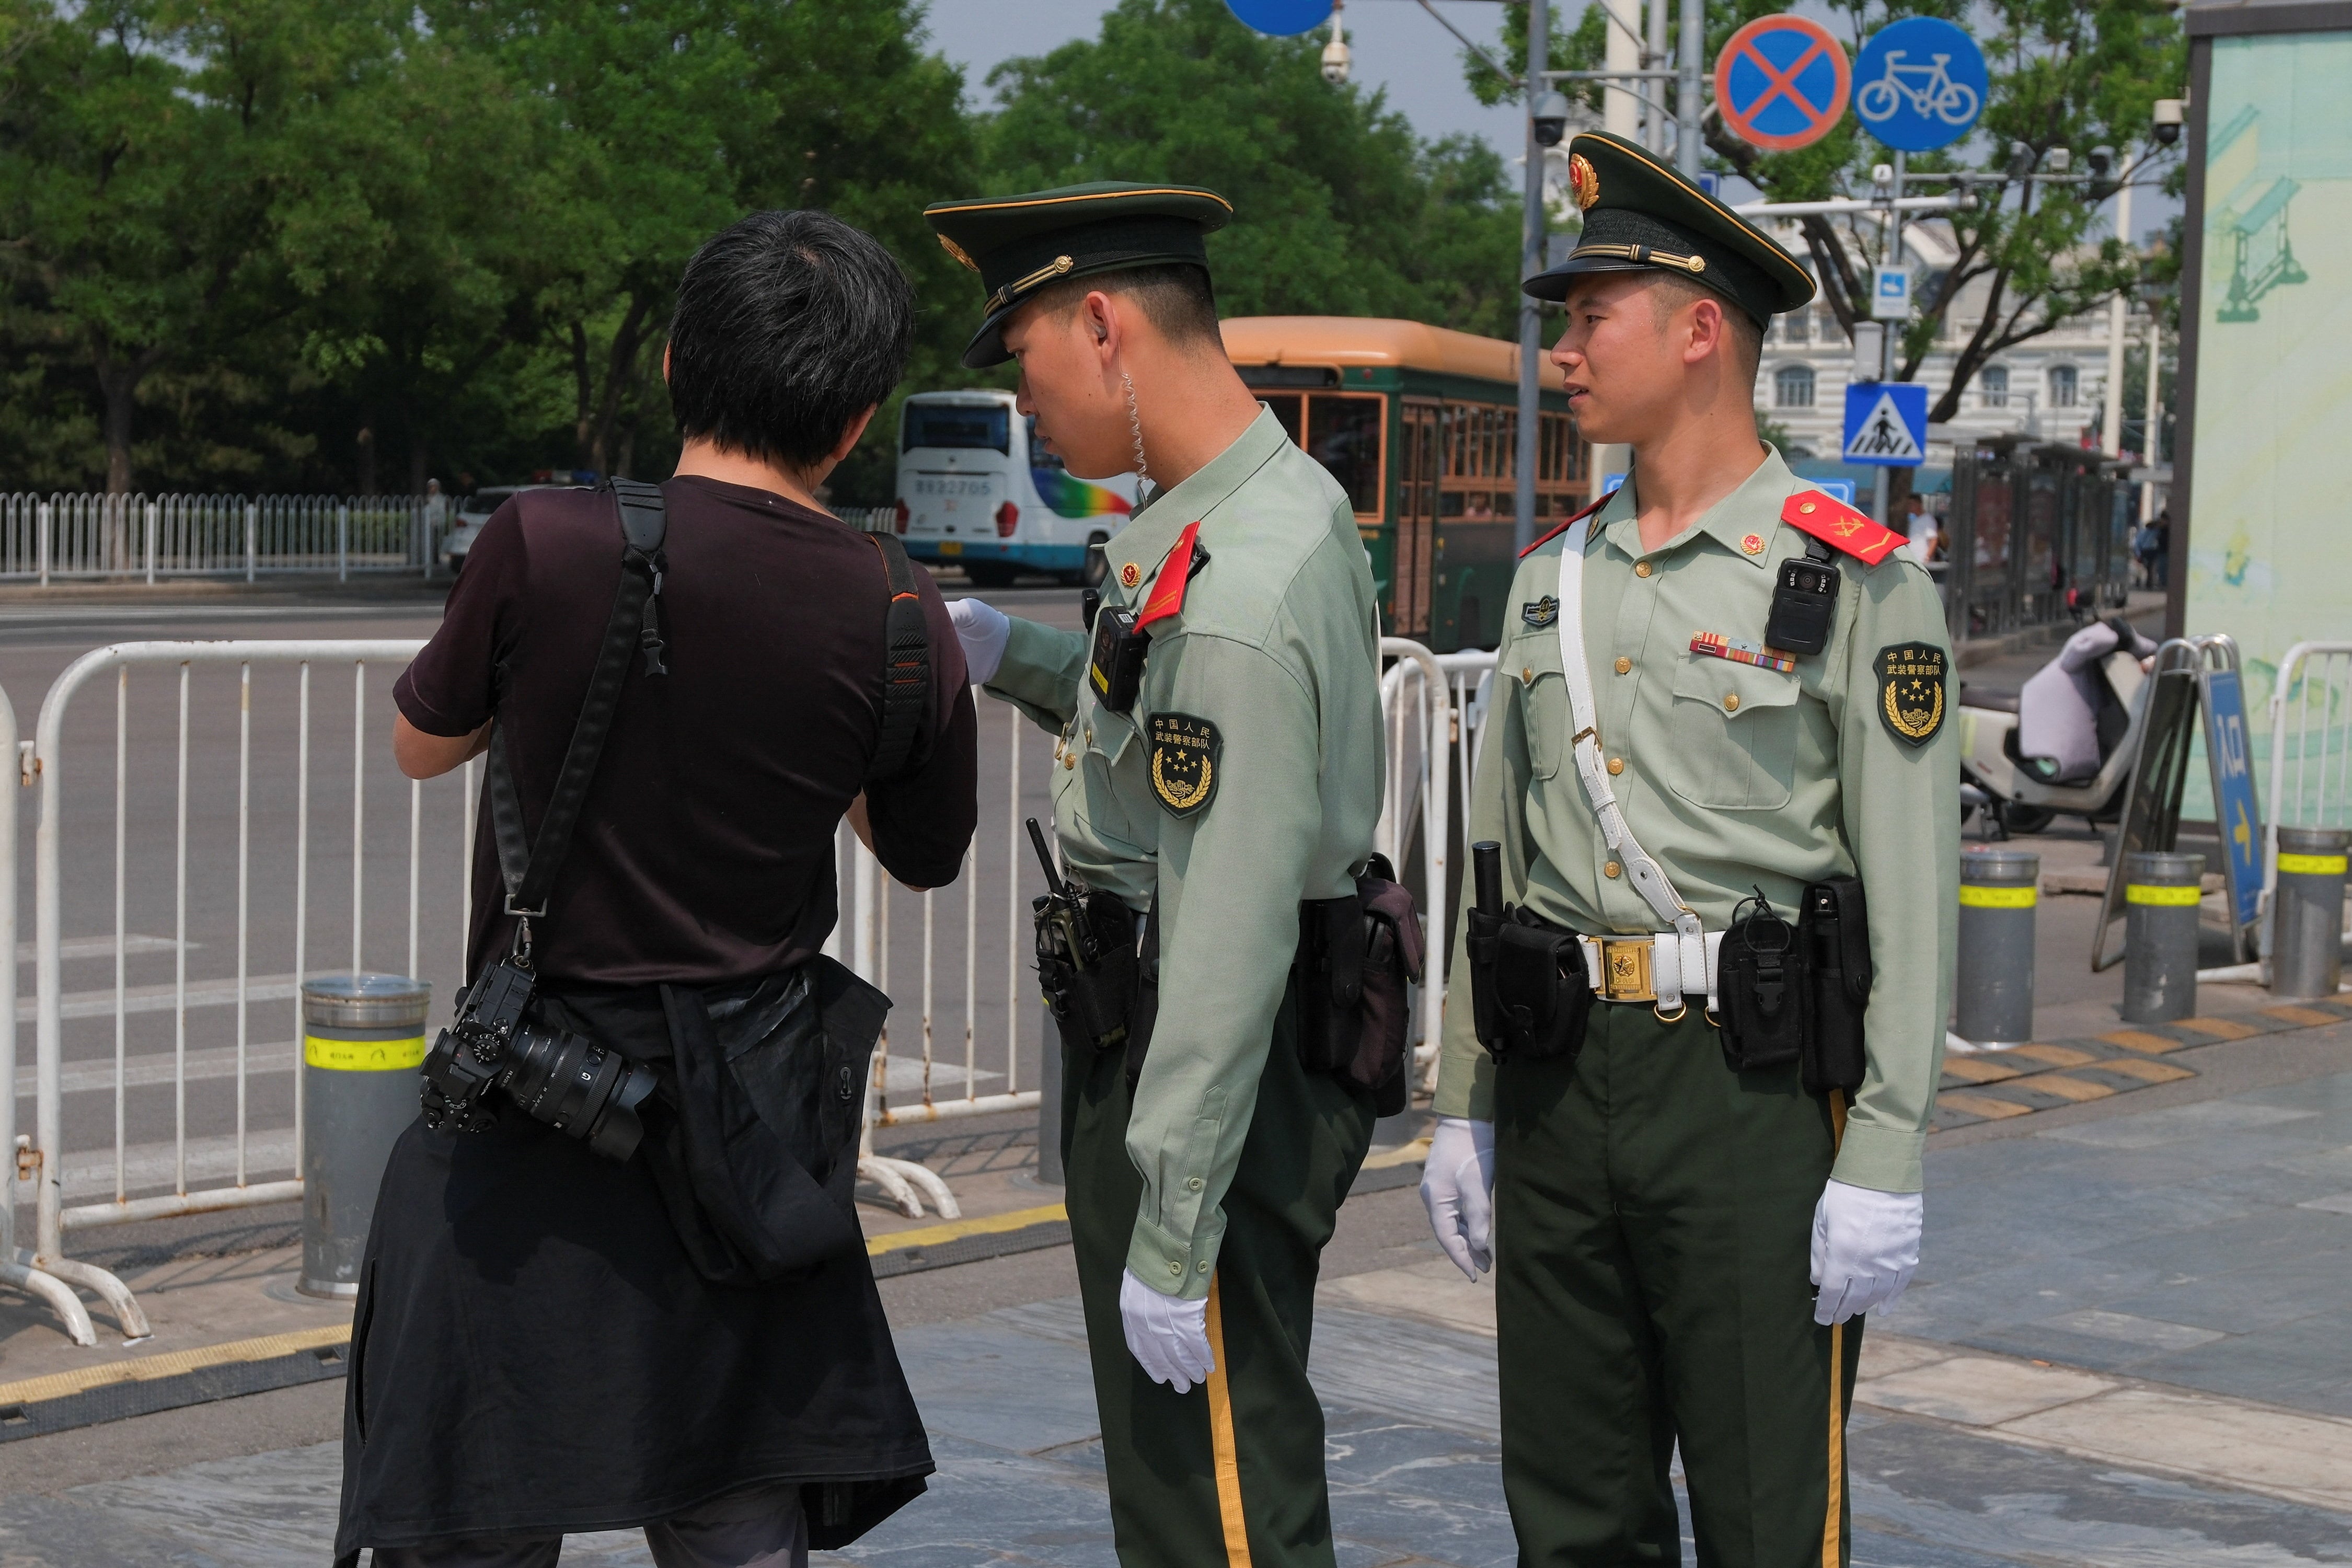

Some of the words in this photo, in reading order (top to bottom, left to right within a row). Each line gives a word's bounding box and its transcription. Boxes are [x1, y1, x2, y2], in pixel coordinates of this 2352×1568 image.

[1887, 650, 1941, 664] 中国人民
[1887, 664, 1942, 676] 武装警察部队
[1155, 718, 1210, 739] 中国人民
[1155, 731, 1210, 750] 武装警察部队
[581, 1072, 591, 1081] G
